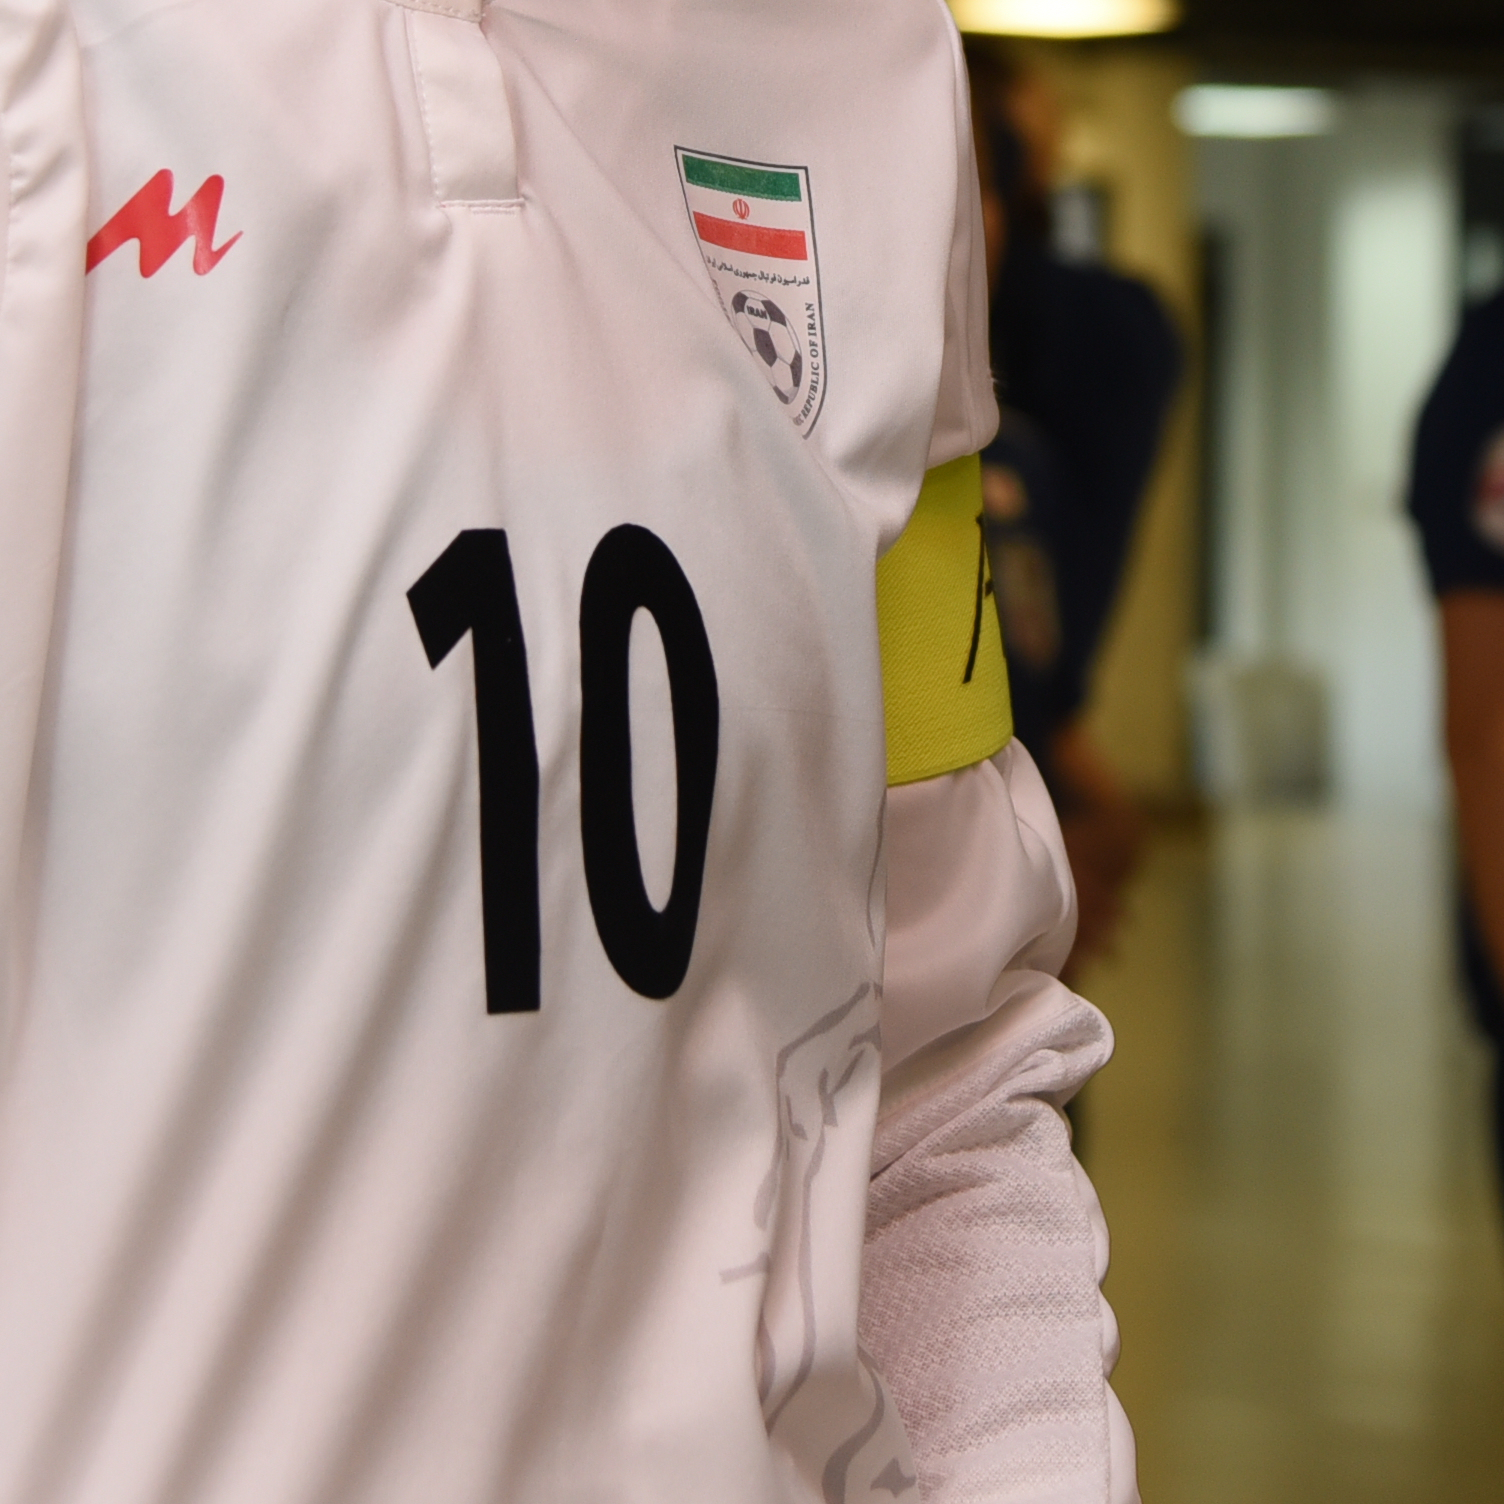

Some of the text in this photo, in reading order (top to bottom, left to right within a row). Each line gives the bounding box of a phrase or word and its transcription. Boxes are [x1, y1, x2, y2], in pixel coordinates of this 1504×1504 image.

[746, 305, 768, 319] IRAN
[800, 302, 819, 420] REPUBLIC OF IRAN
[405, 522, 719, 1014] 10
